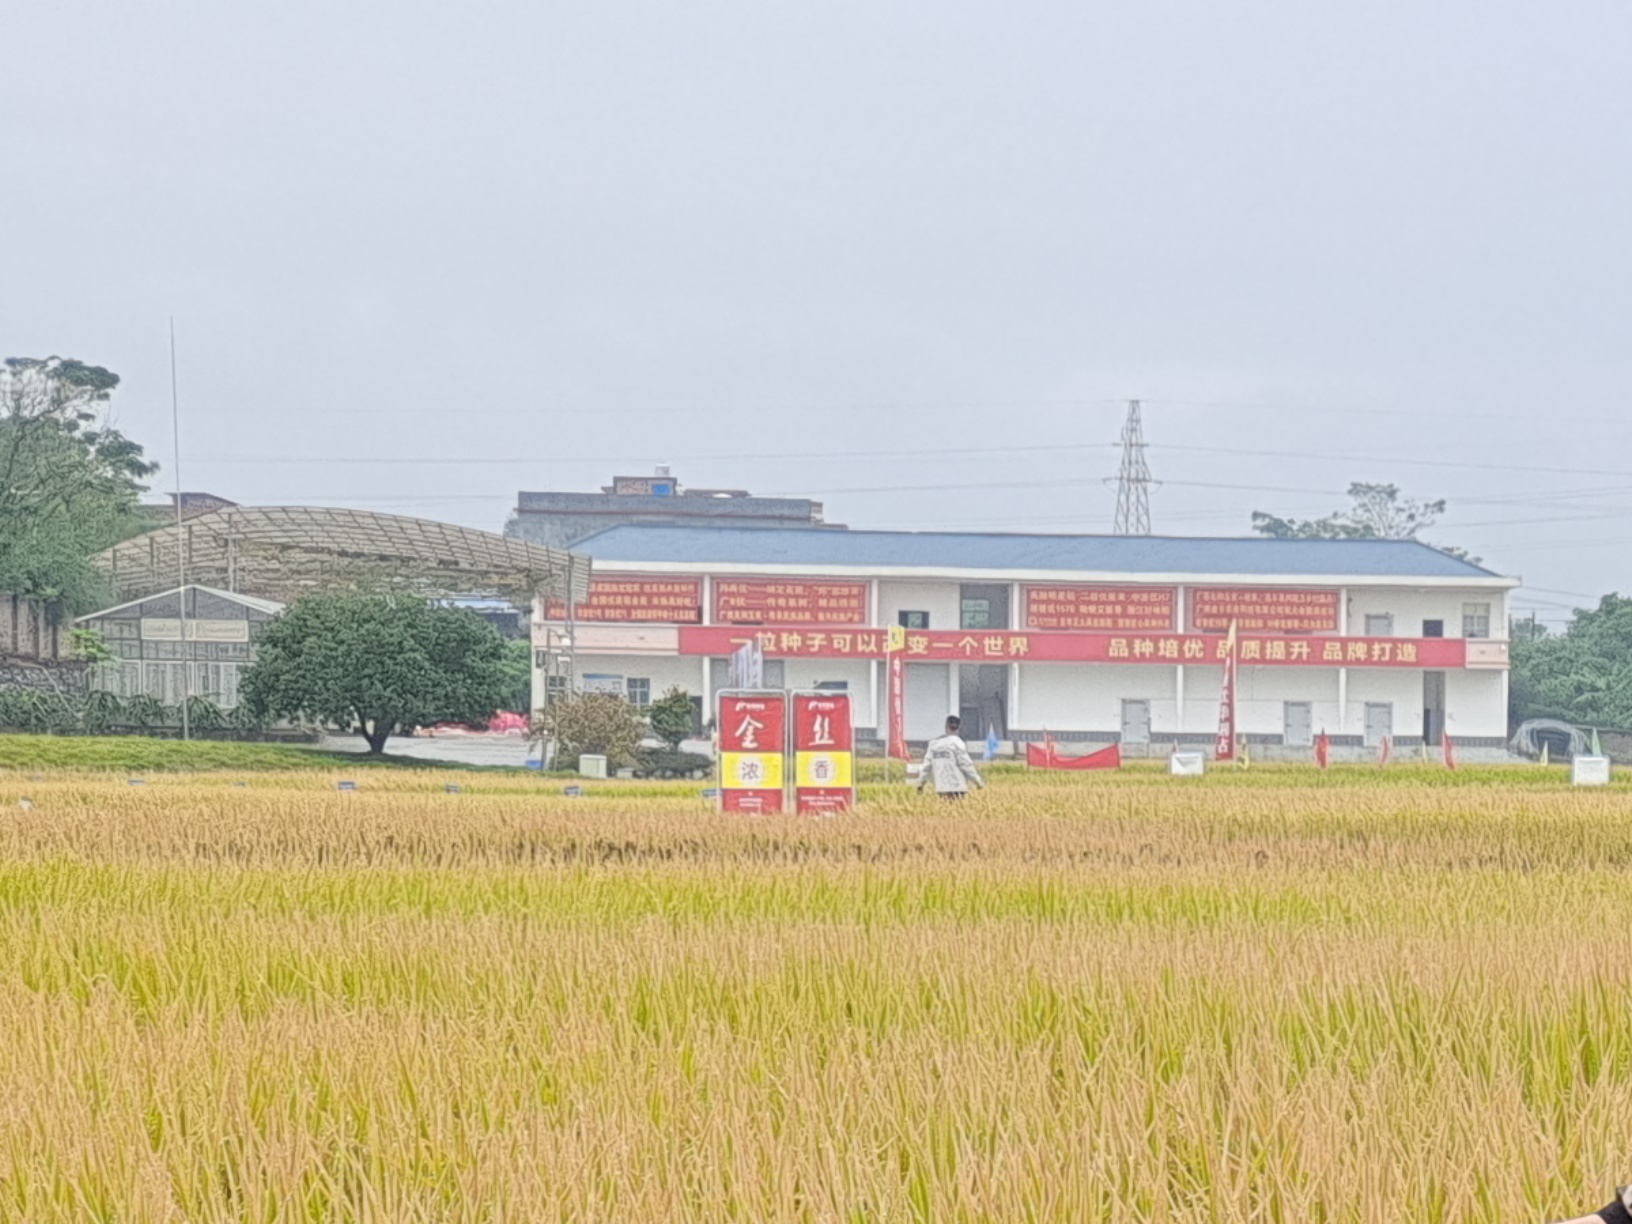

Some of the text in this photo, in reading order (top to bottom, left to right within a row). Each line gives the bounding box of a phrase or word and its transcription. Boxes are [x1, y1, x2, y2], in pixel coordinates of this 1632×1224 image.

[1109, 638, 1418, 662] 品种培优 品质提升 品牌打造
